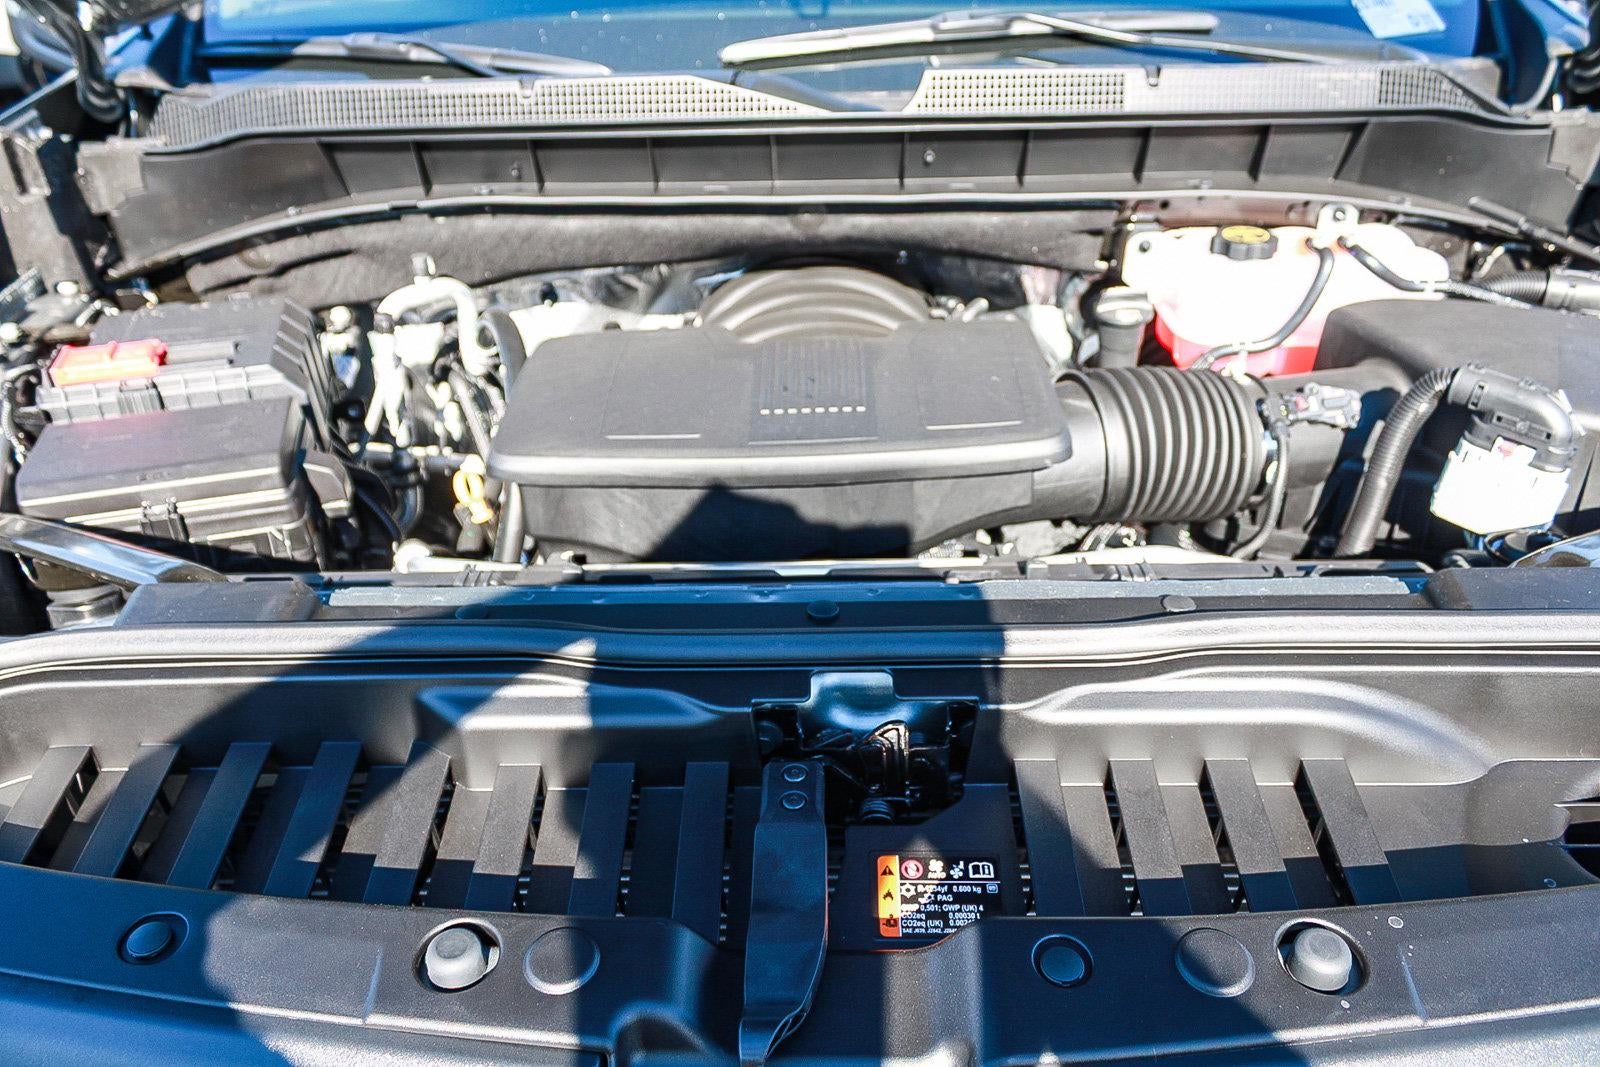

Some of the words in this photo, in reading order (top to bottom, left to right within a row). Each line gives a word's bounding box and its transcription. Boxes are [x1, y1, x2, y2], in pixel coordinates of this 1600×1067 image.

[972, 885, 982, 894] kg
[902, 920, 926, 928] CO2eq
[928, 920, 944, 928] (UK)
